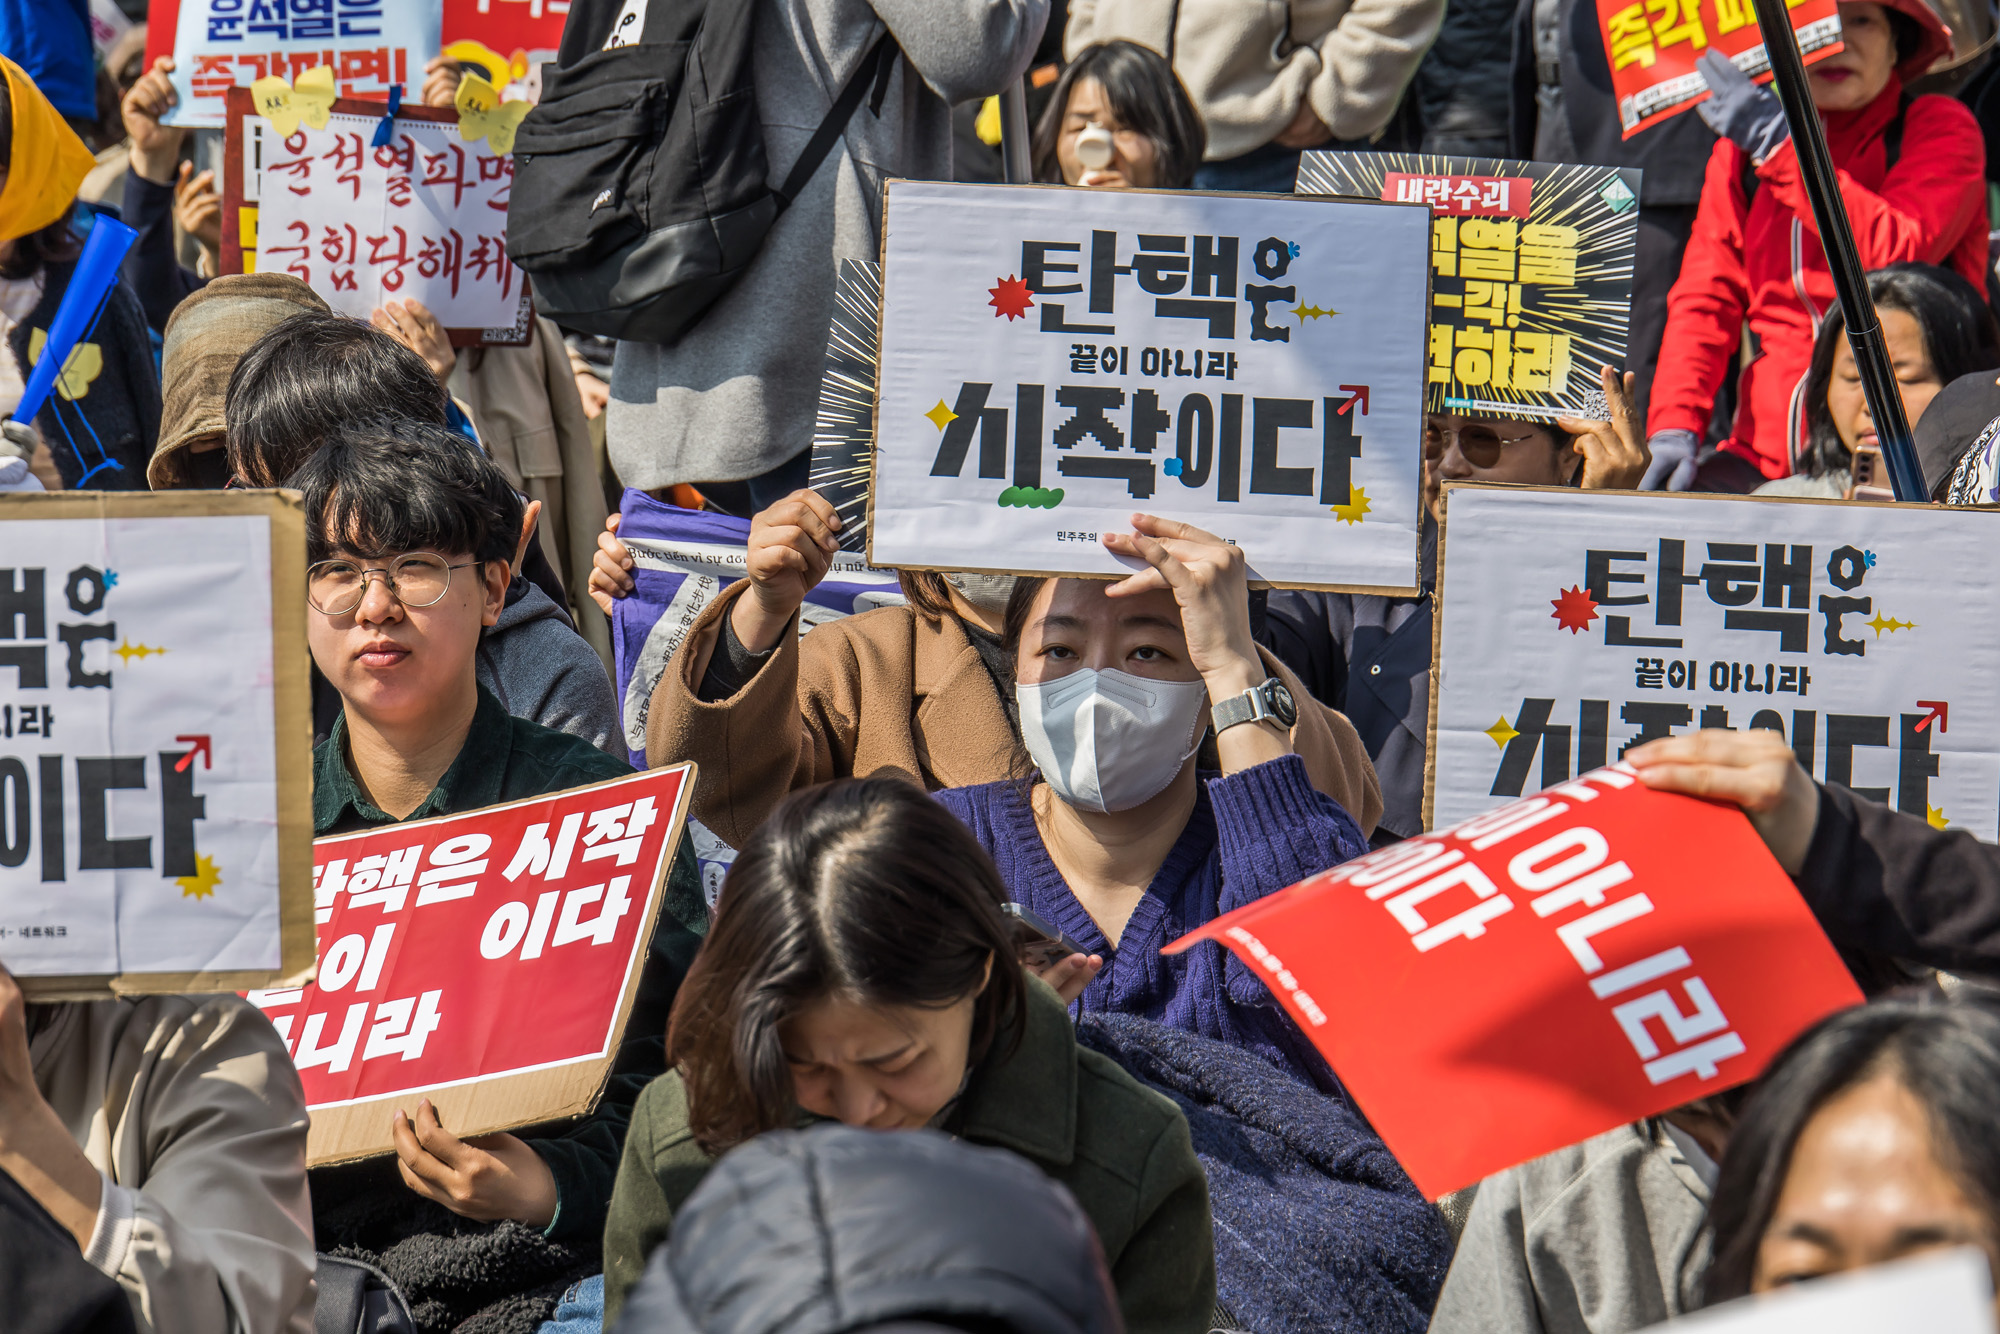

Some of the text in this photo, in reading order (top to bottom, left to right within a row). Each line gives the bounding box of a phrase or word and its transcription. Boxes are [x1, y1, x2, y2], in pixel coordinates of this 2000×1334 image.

[207, 0, 383, 41] 윤석열은
[1608, 0, 1708, 71] 즉각
[1396, 178, 1510, 212] 내란수괴
[1021, 229, 1296, 343] 탄핵은
[1069, 344, 1238, 381] 끝이 아니라
[930, 381, 1362, 506] 시작이다
[706, 554, 722, 567] sự
[1056, 531, 1098, 543] 민주주의
[1585, 538, 1872, 657] 탄핵은
[1635, 657, 1811, 696] 끝이 아니라
[502, 796, 658, 882] 시작
[479, 875, 632, 961] 이다
[1507, 826, 1746, 1085] 아니라
